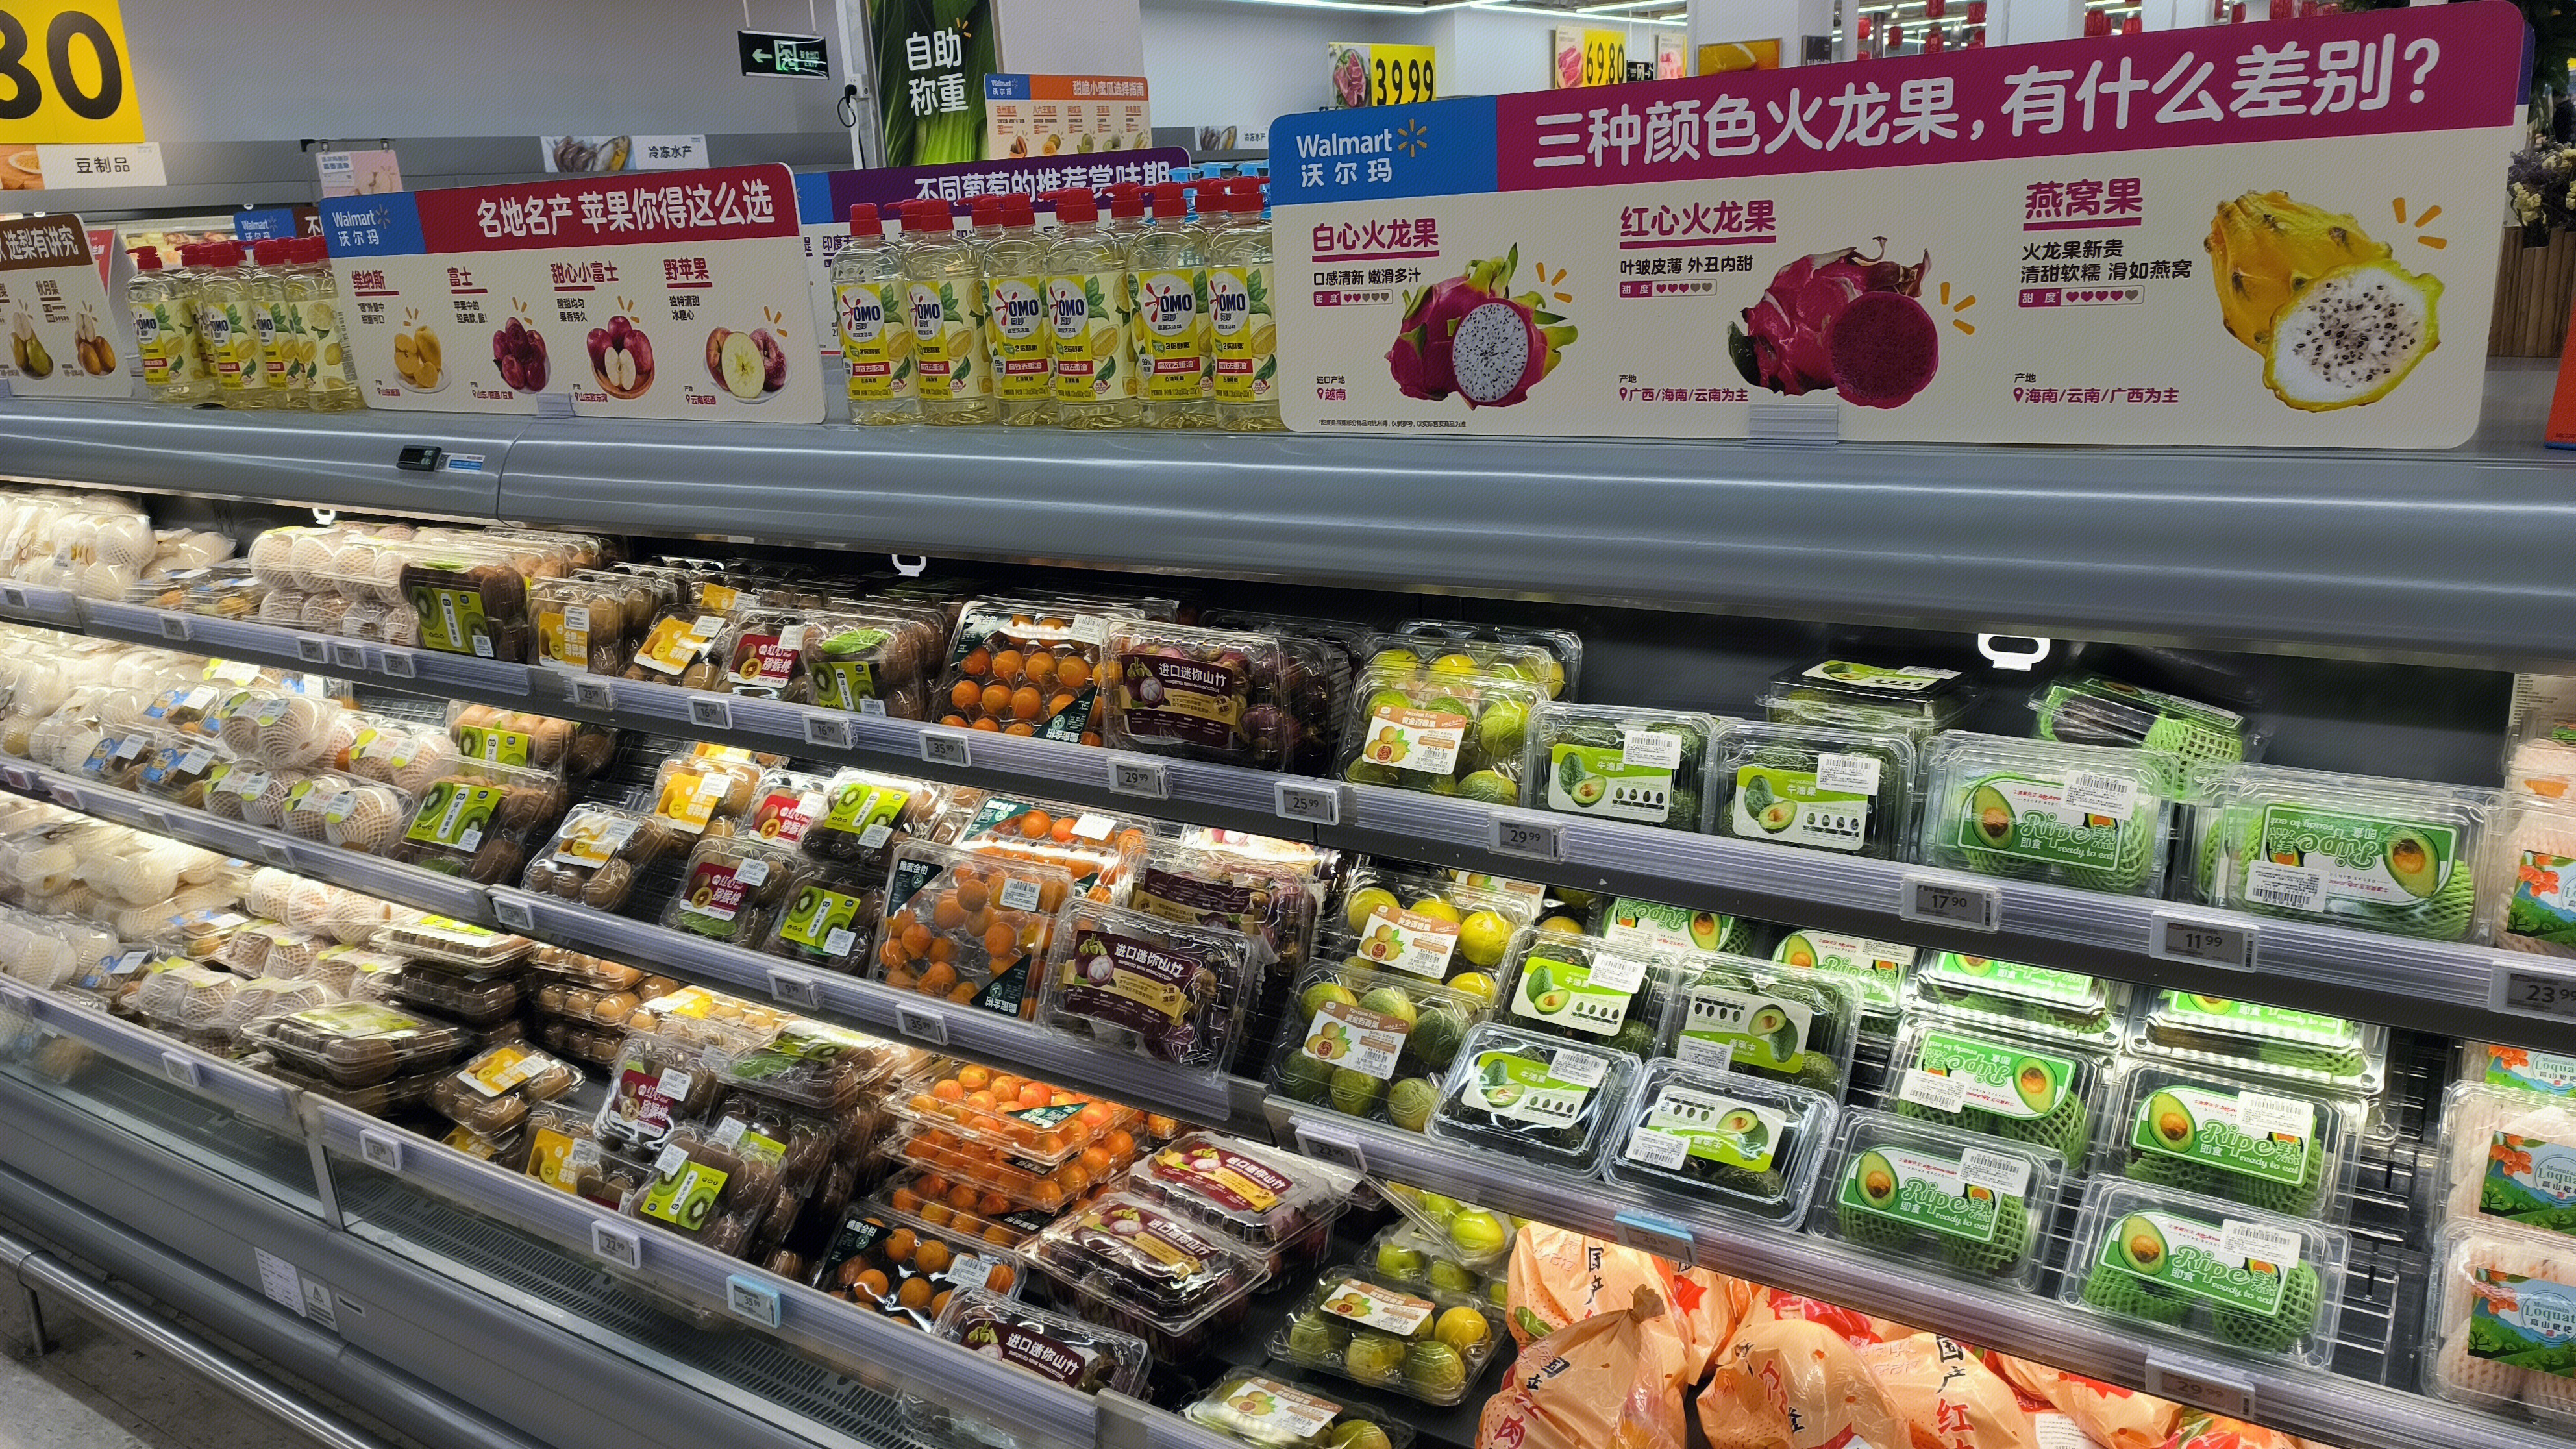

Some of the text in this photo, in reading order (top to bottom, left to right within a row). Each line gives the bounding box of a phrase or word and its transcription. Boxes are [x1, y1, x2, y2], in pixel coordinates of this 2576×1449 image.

[906, 27, 962, 71] 自助
[908, 73, 969, 117] 称重
[1072, 80, 1144, 97] 甜脆小蜜瓜选择指南
[649, 145, 693, 159] 冷冻水产
[1297, 129, 1393, 159] Walmart
[76, 157, 130, 173] 豆制品
[1300, 158, 1393, 188] 沃尔玛
[2025, 177, 2144, 219] 燕窝果
[477, 179, 776, 238] 名地名产 苹果你得这么选
[241, 221, 269, 232] Walmart
[332, 210, 375, 229] Walmart
[1620, 199, 1777, 237] 红心火龙果
[0, 224, 79, 261] 选梨有讲究
[338, 229, 379, 247] 沃尔玛
[1313, 218, 1439, 251] 白心火龙果
[2022, 238, 2124, 261] 火龙果新贵
[550, 260, 619, 284] 甜心小富士
[663, 257, 710, 280] 野苹果
[1620, 254, 1753, 275] 叶皱皮薄 外丑内甜
[2020, 258, 2193, 284] 清甜软糯 滑如燕窝
[351, 269, 386, 290] 维纳斯
[447, 266, 473, 287] 富士
[1313, 267, 1422, 286] 口感清新 嫩滑多汁
[556, 297, 585, 310] 酸甜均匀
[669, 295, 700, 308] 独特清甜
[1009, 299, 1039, 317] OMO
[1059, 299, 1085, 316] OMO
[1160, 294, 1193, 312] OMO
[1219, 295, 1246, 312] OMO
[559, 310, 588, 323] 果香持久
[671, 309, 695, 321] 冰糖心
[853, 306, 881, 322] OMO
[917, 304, 941, 319] OMO
[1317, 375, 1346, 384] 进口产地
[1619, 374, 1637, 384] 产地
[2014, 372, 2037, 384] 产地
[1325, 388, 1347, 401] 越南
[1629, 388, 1749, 402] 广西/海南/云南为主
[2025, 388, 2180, 404] 海南/云南/广西为主
[1159, 663, 1226, 687] 进口迷你山竹
[817, 725, 836, 737] 16.99
[934, 742, 954, 756] 35.99
[1787, 784, 1817, 797] 牛油果
[1292, 797, 1320, 810] 25.99
[2020, 809, 2092, 848] Ripe
[2020, 837, 2043, 850] 即食
[2057, 845, 2085, 858] ready
[2098, 850, 2115, 861] eat
[1114, 943, 1184, 976] 进口迷你山竹
[1344, 1013, 1380, 1030] 黄金百香果
[2535, 1060, 2576, 1073] Loqua
[2199, 1119, 2276, 1156] Ripe
[2199, 1142, 2223, 1157] 即食
[2238, 1155, 2268, 1170] ready
[2281, 1164, 2299, 1174] eat
[1901, 1176, 1972, 1215] Ripe
[2542, 1180, 2576, 1195] 高山枇
[1900, 1200, 1922, 1215] 即食
[1935, 1211, 1962, 1227] ready
[1974, 1220, 1990, 1232] eat
[2174, 1244, 2251, 1287] Ripe
[2170, 1267, 2194, 1283] 即食
[2211, 1281, 2240, 1297] ready
[2256, 1291, 2273, 1304] eat
[2533, 1300, 2570, 1314] Mountain
[1006, 1332, 1080, 1377] 进口迷你山竹
